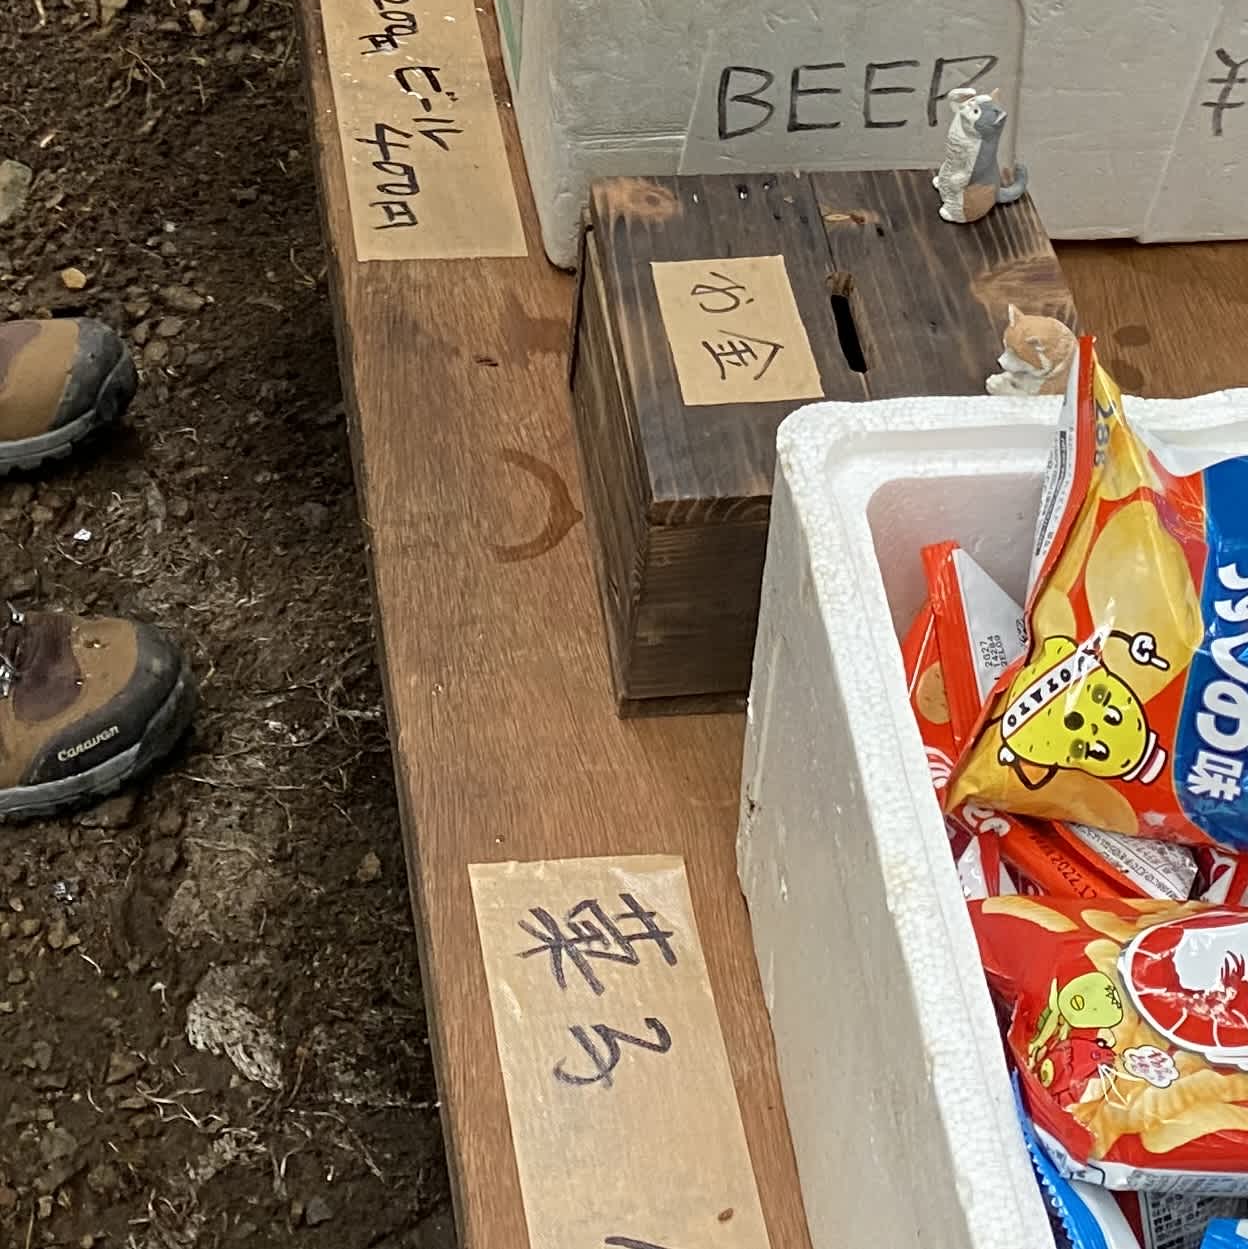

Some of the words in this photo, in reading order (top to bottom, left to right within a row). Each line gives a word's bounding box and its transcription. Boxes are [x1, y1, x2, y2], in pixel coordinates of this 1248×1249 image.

[689, 270, 785, 381] お金
[57, 723, 120, 764] Caravan
[514, 892, 679, 1090] 菓子
